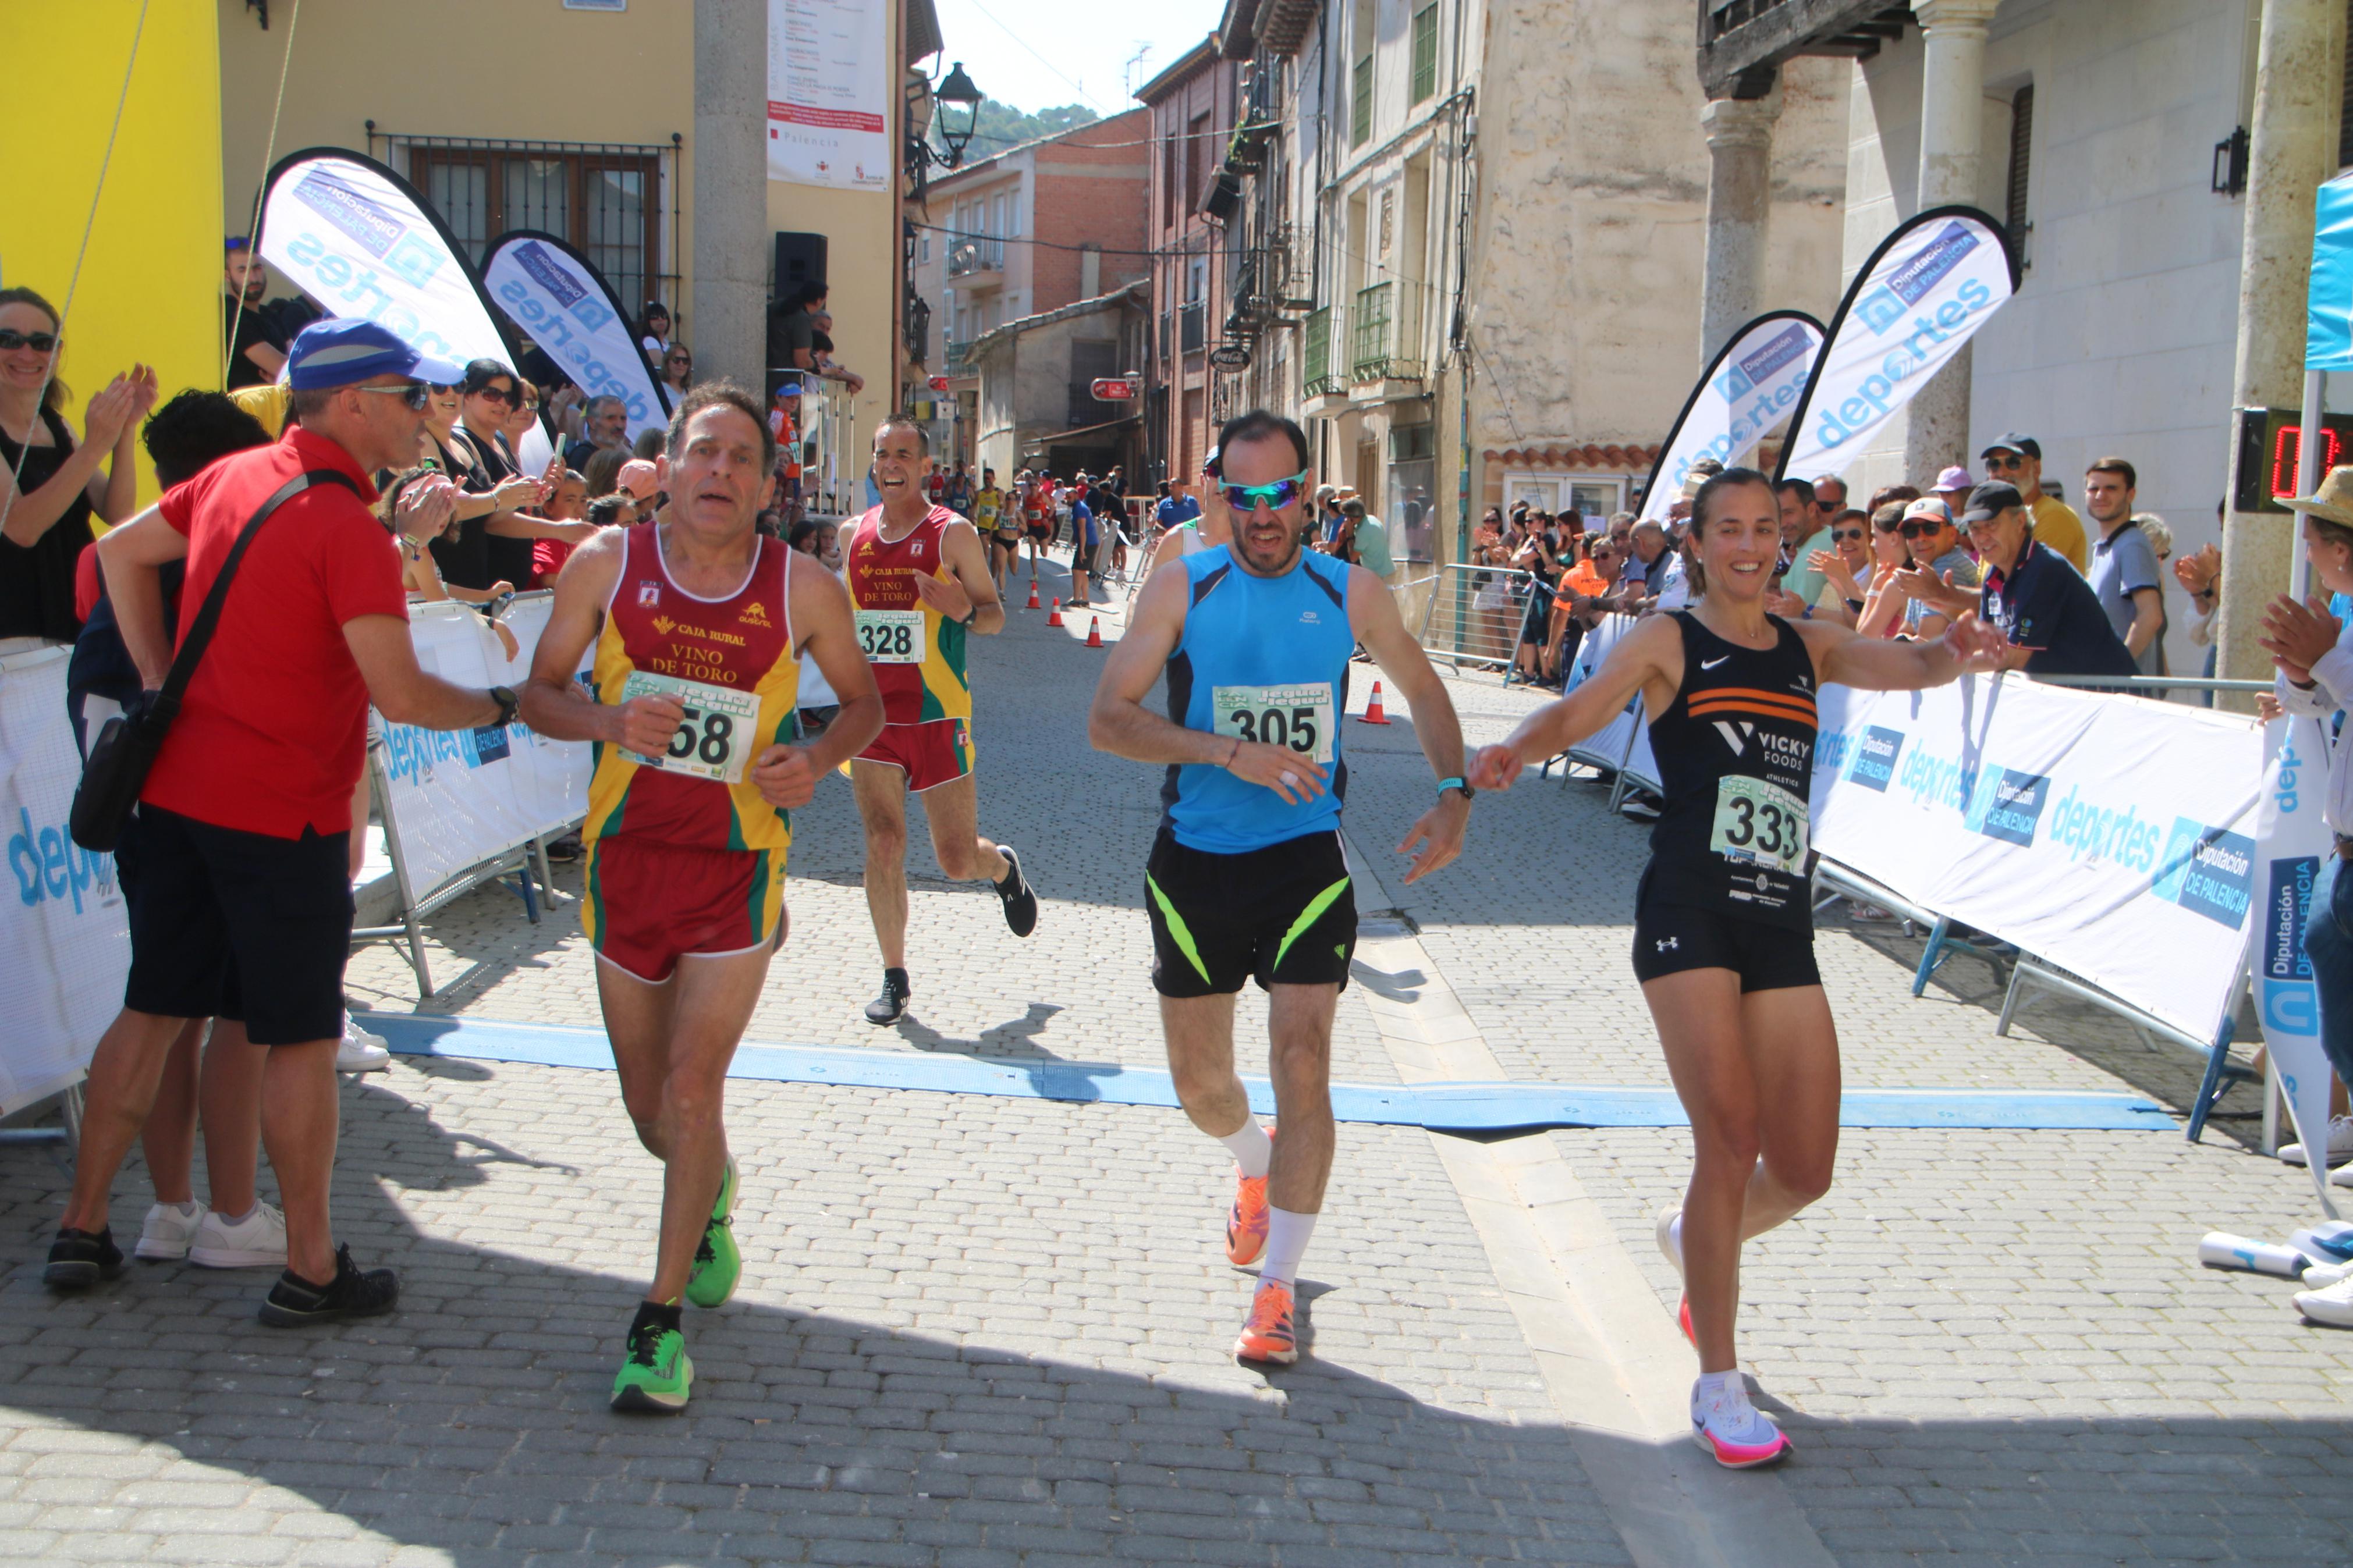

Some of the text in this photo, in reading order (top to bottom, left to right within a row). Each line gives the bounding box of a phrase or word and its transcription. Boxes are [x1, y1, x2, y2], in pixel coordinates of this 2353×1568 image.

[784, 131, 839, 147] Palencia
[1903, 236, 1974, 301] DE PALENCIA
[1213, 351, 1244, 363] Coca-Cola
[1743, 336, 1794, 372] Diputación
[1752, 337, 1812, 381] DE PALENCIA
[1817, 278, 1990, 449] deportes
[865, 592, 912, 602] DE TORO
[874, 581, 902, 591] VINO
[678, 624, 746, 646] CAJA RURAL
[739, 616, 772, 628] austral
[861, 625, 912, 655] 328
[671, 643, 723, 665] VINO
[652, 657, 737, 683] DE TORO
[677, 683, 751, 708] legua
[1261, 689, 1324, 698] legua
[1230, 707, 1316, 753] 305
[1758, 732, 1809, 758] VICKY
[1764, 751, 1802, 771] FOODS
[1766, 773, 1798, 787] ATHLETICS
[1900, 737, 1976, 812] deportes
[1724, 796, 1799, 861] 333
[2050, 783, 2160, 873] deportes
[2196, 838, 2249, 877] Diputación
[2185, 872, 2248, 915] DE PALENCIA
[2272, 884, 2293, 975] Diputación
